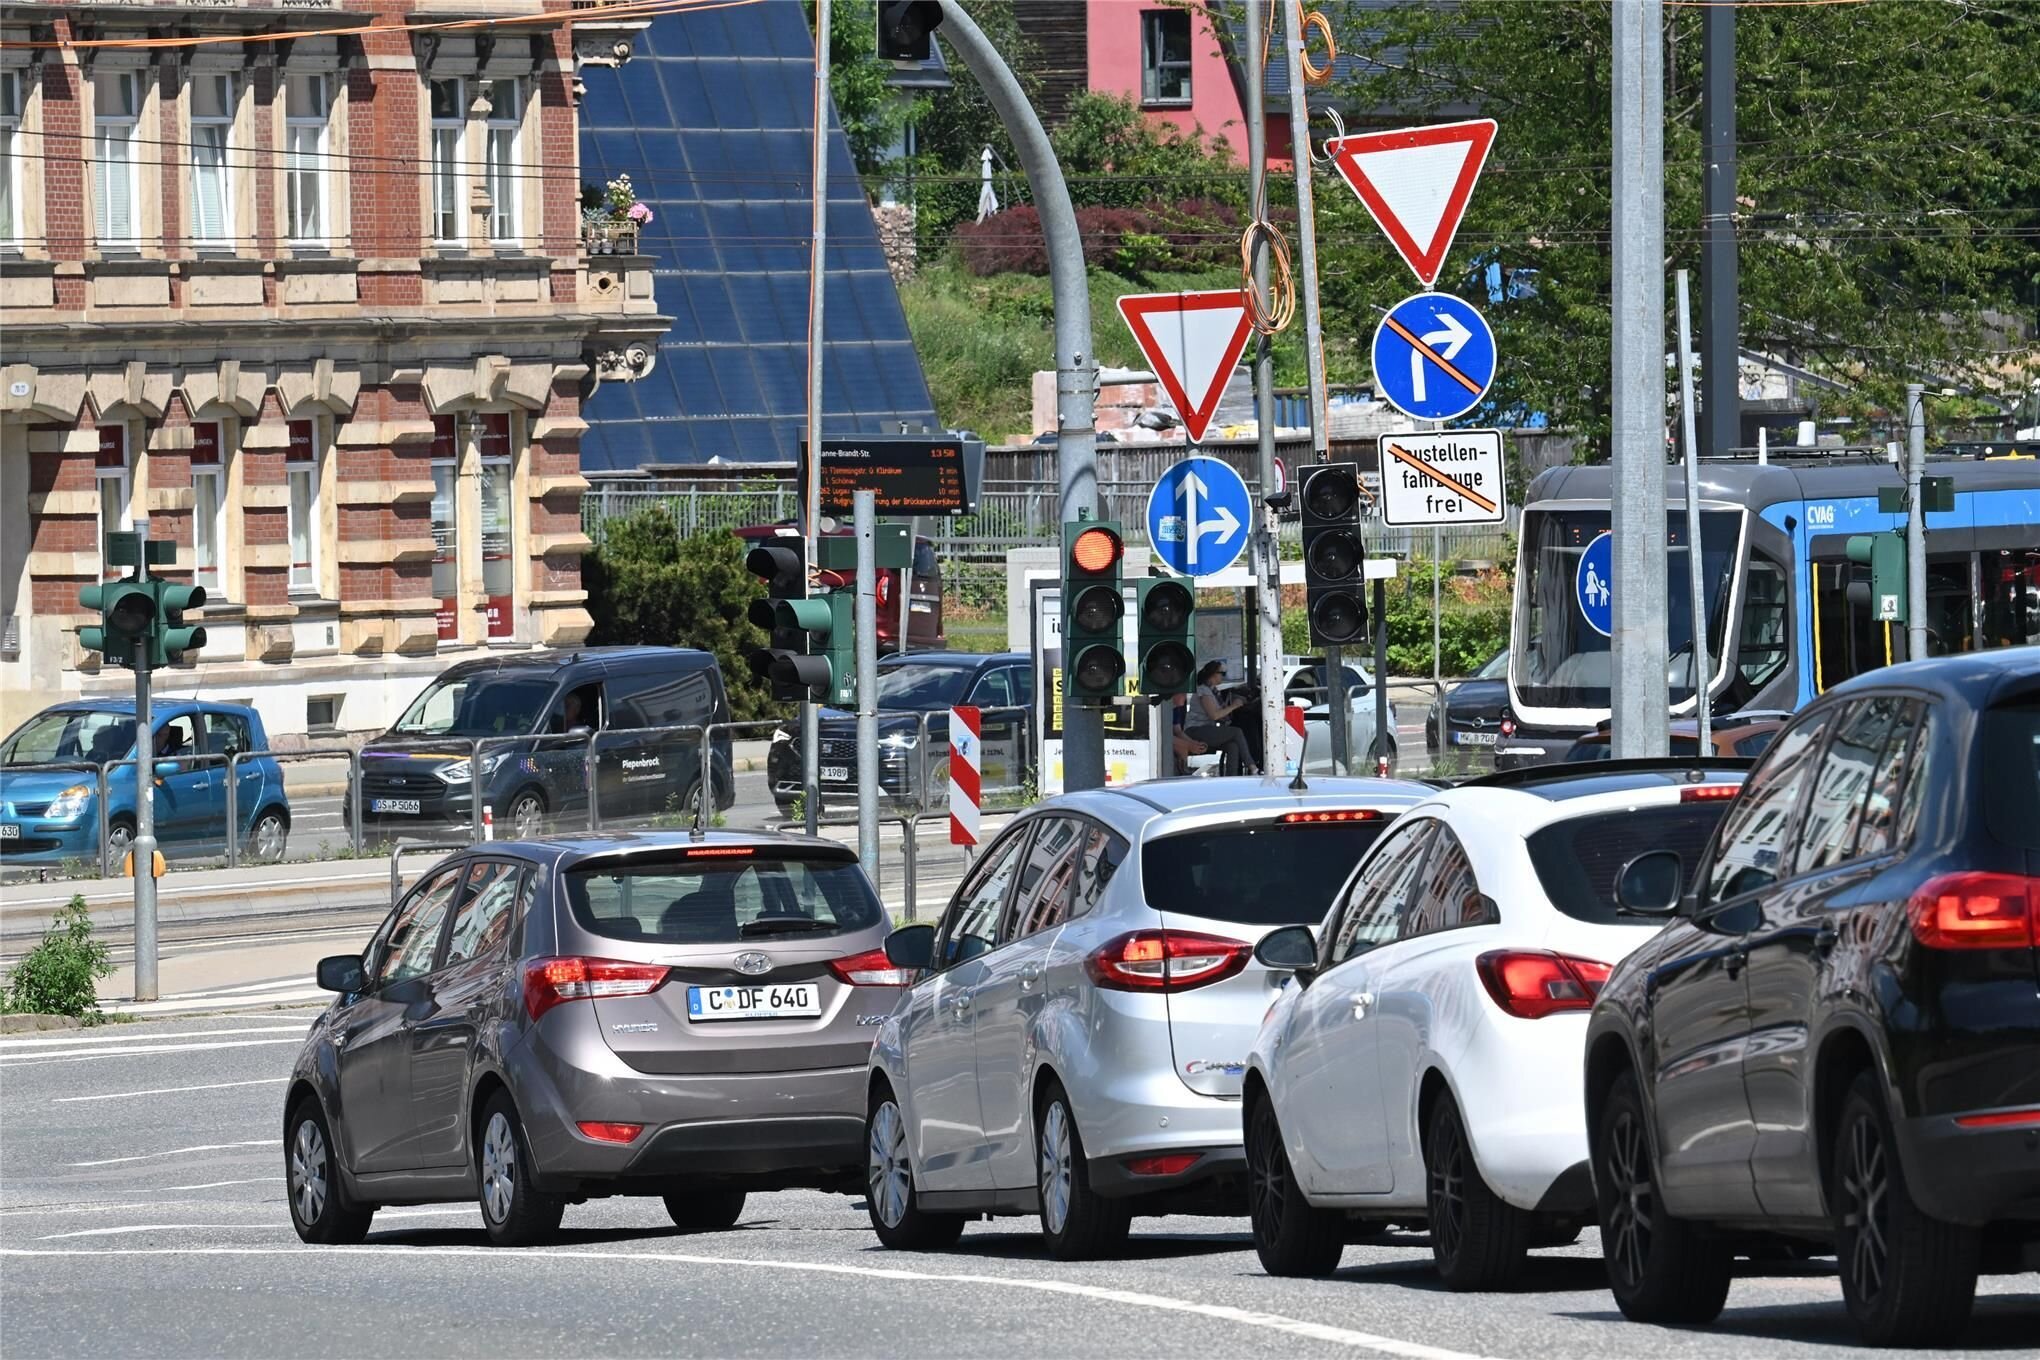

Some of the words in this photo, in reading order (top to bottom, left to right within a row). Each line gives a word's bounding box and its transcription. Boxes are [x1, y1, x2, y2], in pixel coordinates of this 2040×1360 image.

[1426, 495, 1463, 513] frei
[1807, 504, 1834, 524] CVAG
[622, 757, 660, 770] Piepenbrock
[828, 768, 847, 777] 1989
[398, 801, 419, 811] 5066
[1, 826, 18, 836] 630
[709, 991, 723, 1010] C
[737, 989, 764, 1009] DF
[770, 988, 808, 1008] 640
